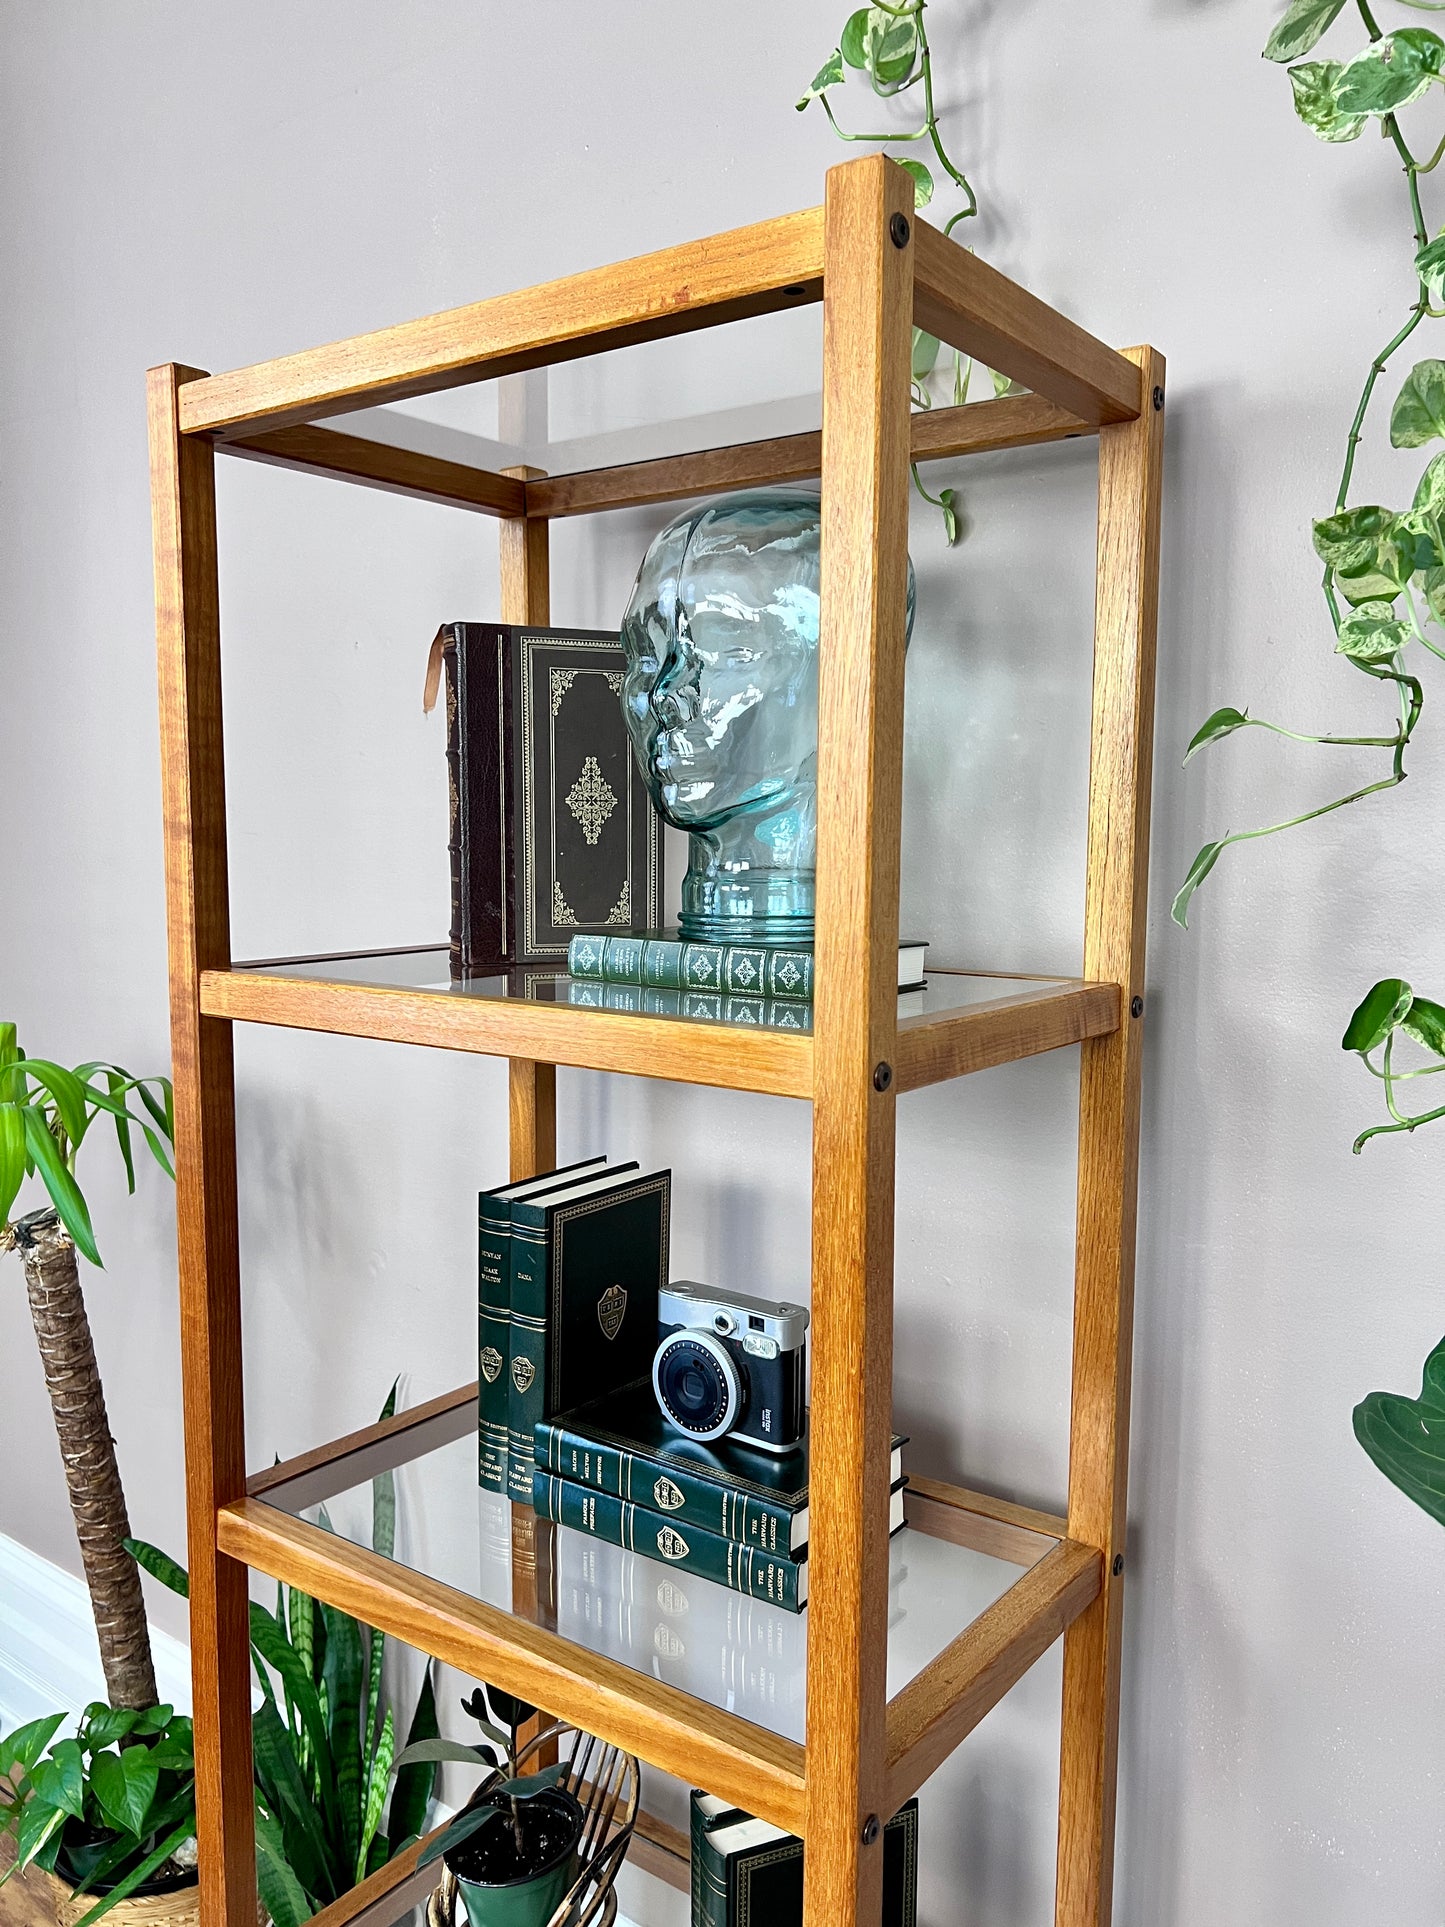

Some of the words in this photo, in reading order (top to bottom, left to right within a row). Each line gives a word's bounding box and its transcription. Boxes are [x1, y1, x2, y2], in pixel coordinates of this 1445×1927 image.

[760, 1512, 768, 1548] HARVARD
[769, 1516, 777, 1551] CLASSICS
[767, 1563, 775, 1599] HARVARD
